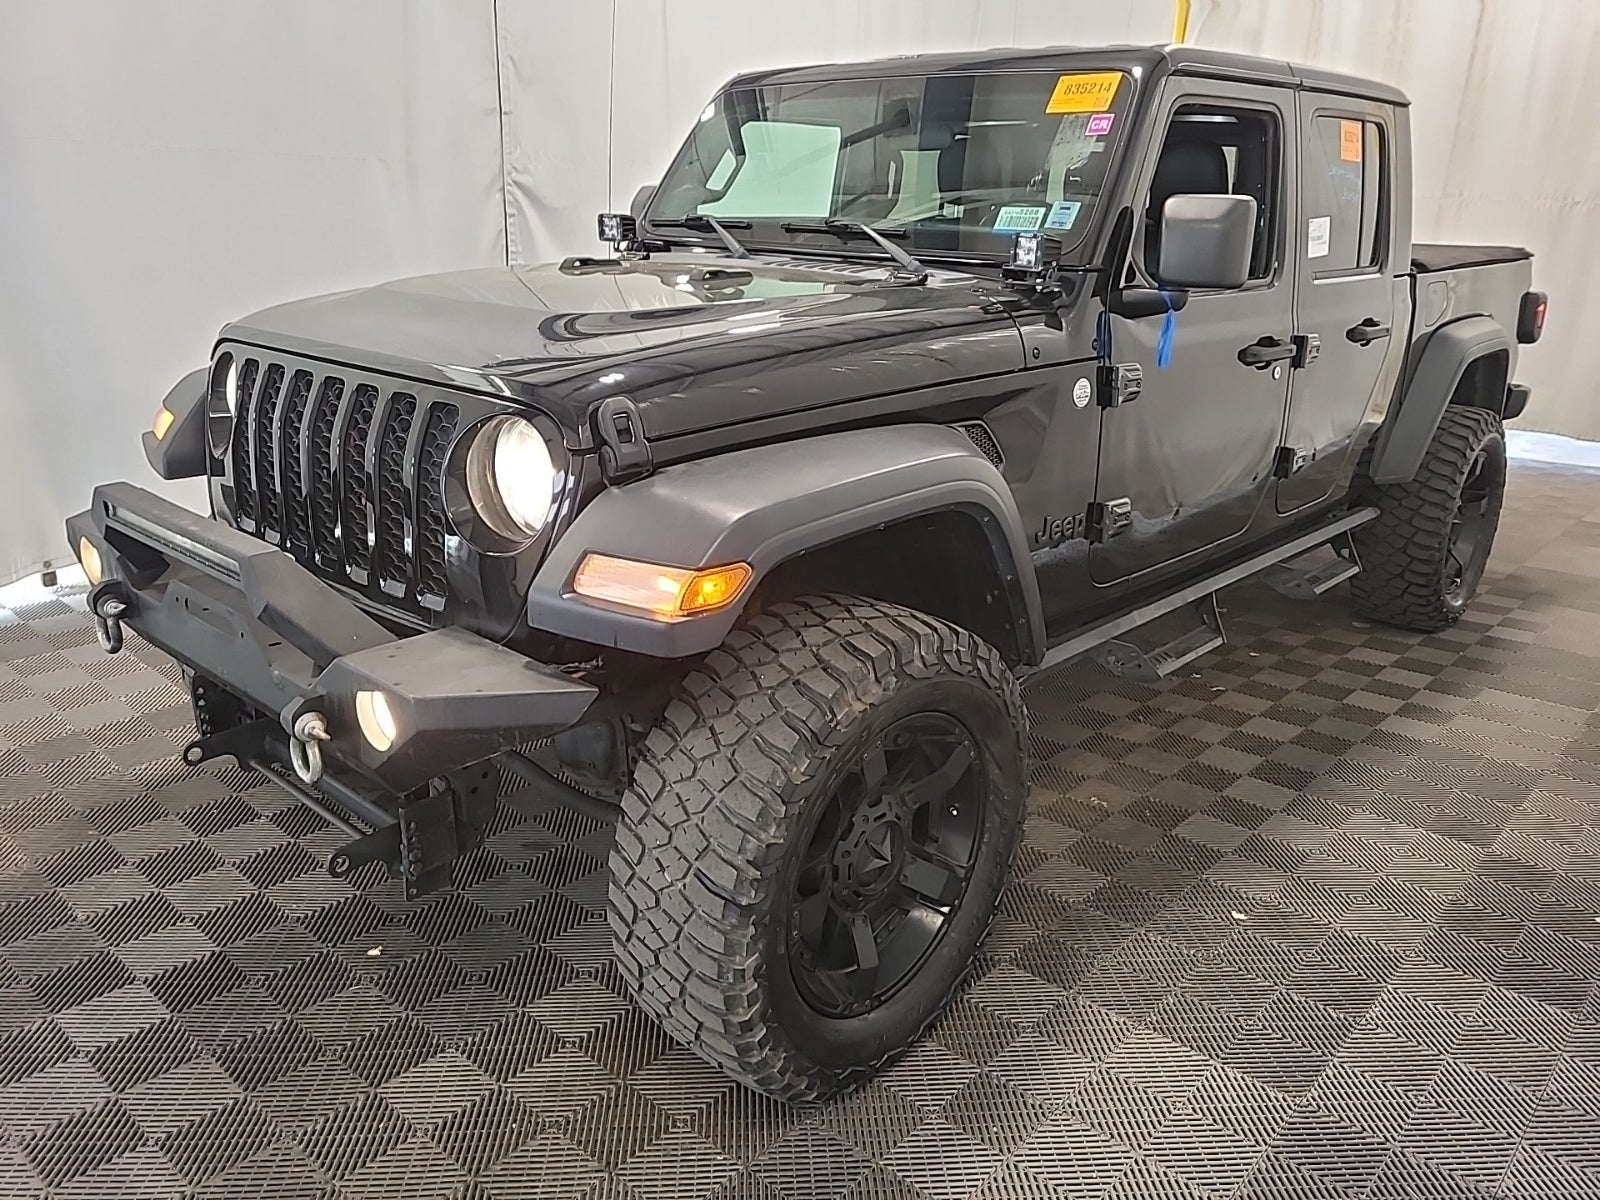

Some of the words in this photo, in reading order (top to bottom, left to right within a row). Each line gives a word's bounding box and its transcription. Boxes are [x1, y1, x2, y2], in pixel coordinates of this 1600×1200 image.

[1063, 82, 1112, 96] 835214
[1091, 119, 1109, 130] CR
[1035, 513, 1086, 544] Jeep
